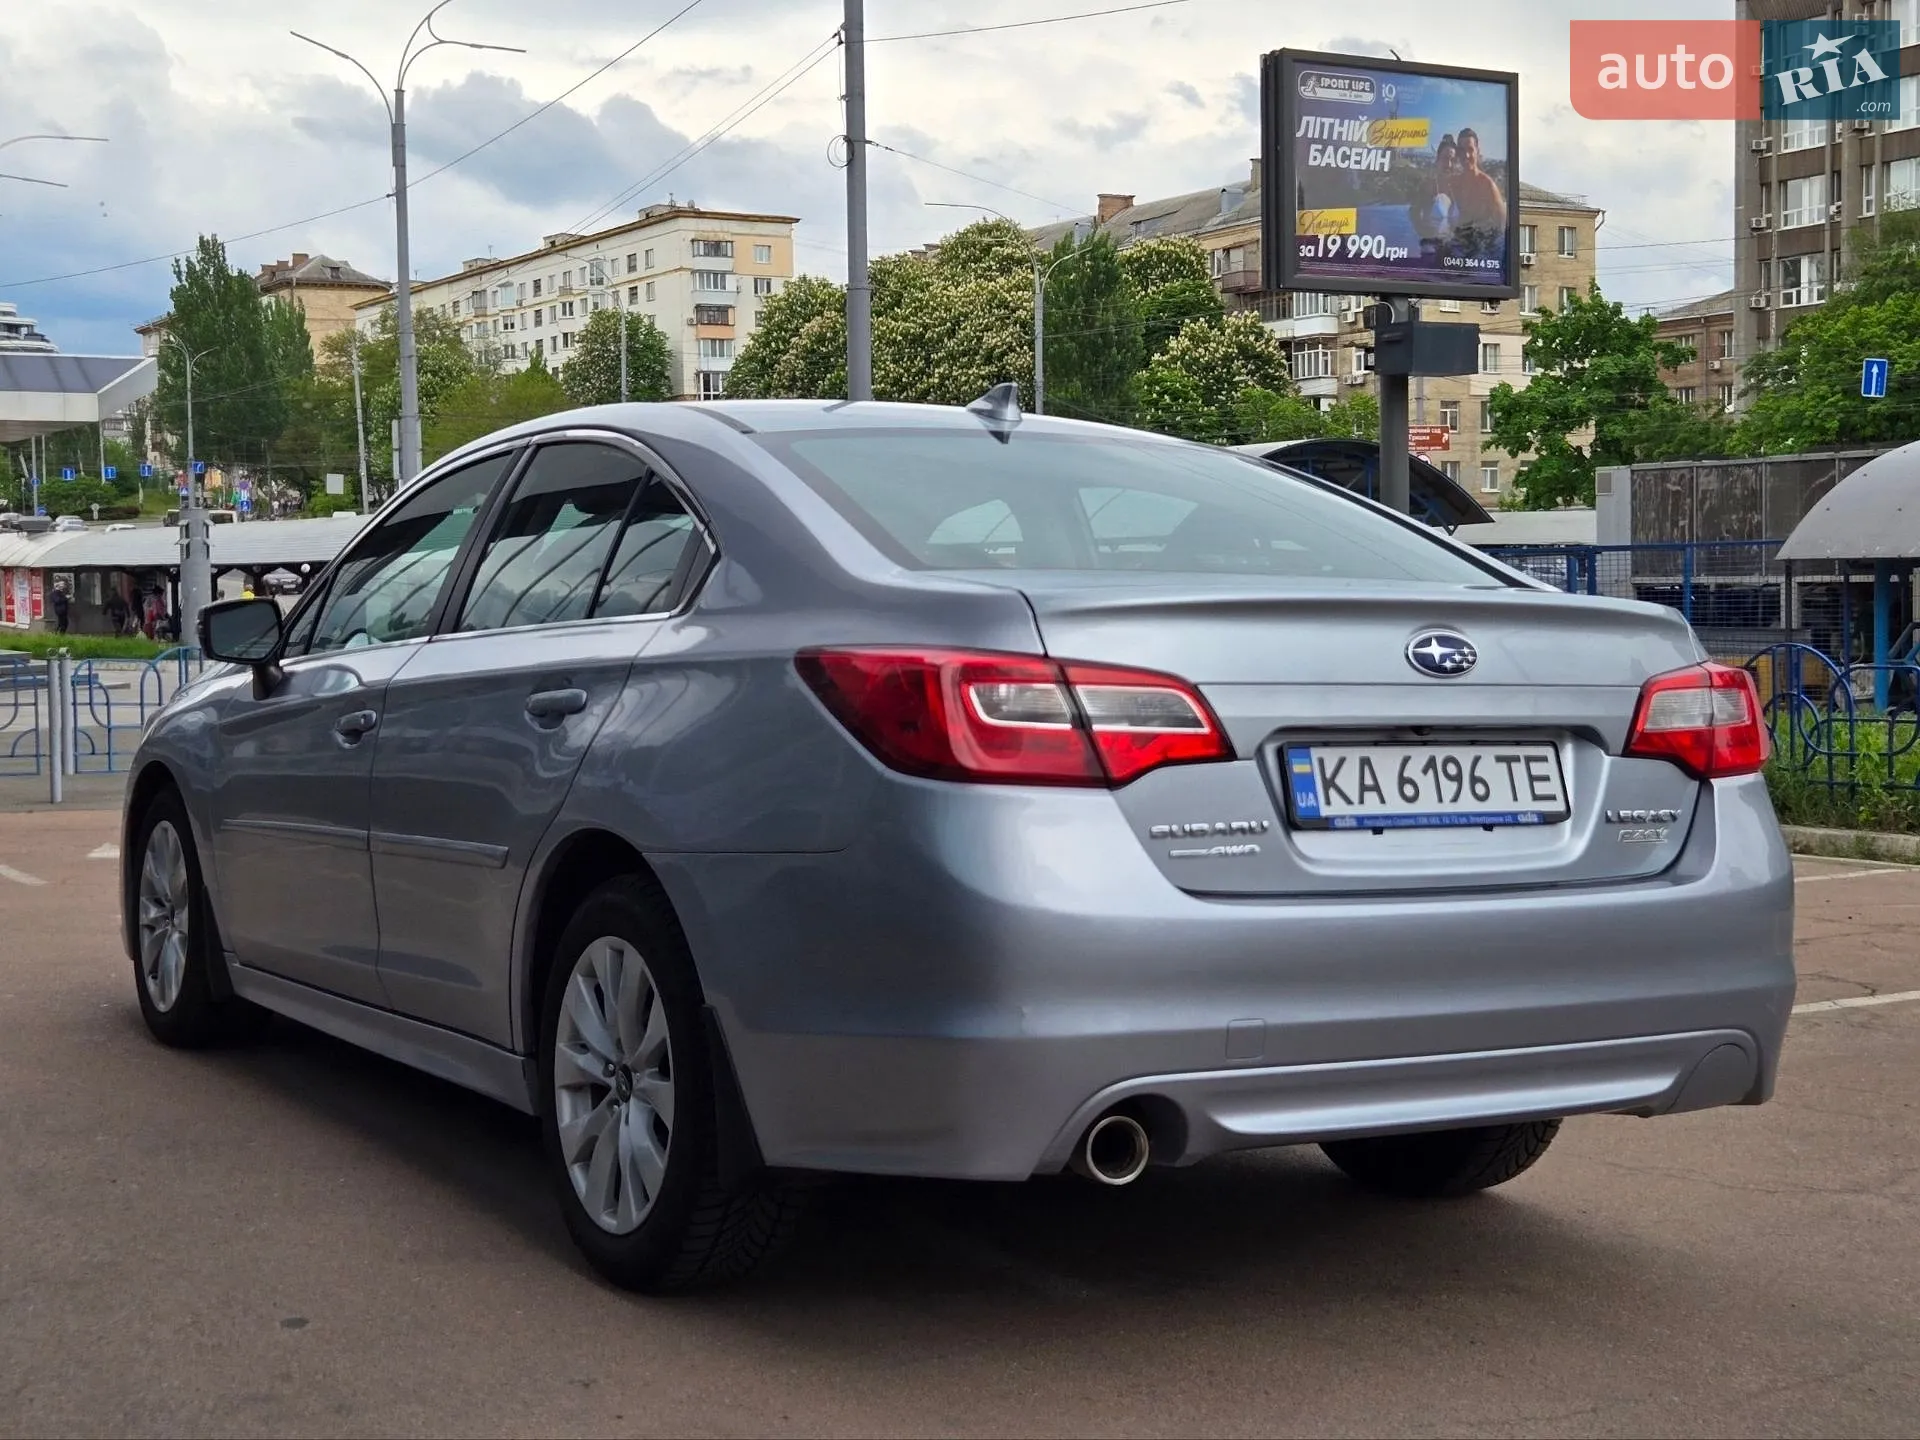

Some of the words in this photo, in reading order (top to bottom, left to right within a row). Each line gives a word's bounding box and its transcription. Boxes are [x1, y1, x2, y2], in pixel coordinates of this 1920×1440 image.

[1320, 76, 1350, 89] SPORT
[1351, 80, 1371, 92] LIFE
[1296, 115, 1369, 143] ЛІТНІЙ
[1308, 144, 1392, 172] БАСЕЙН
[1299, 245, 1315, 257] за
[1316, 233, 1341, 257] 19
[1347, 235, 1386, 259] 990
[1385, 245, 1408, 260] грн
[1443, 256, 1464, 267] (044)
[1486, 259, 1500, 269] 575
[1317, 756, 1386, 806] KA
[1397, 755, 1491, 804] 6196
[1494, 754, 1558, 802] TE
[1297, 791, 1317, 808] UA
[1605, 808, 1682, 824] LEGACY
[1149, 820, 1270, 839] SUBARU
[1206, 844, 1261, 857] AWD
